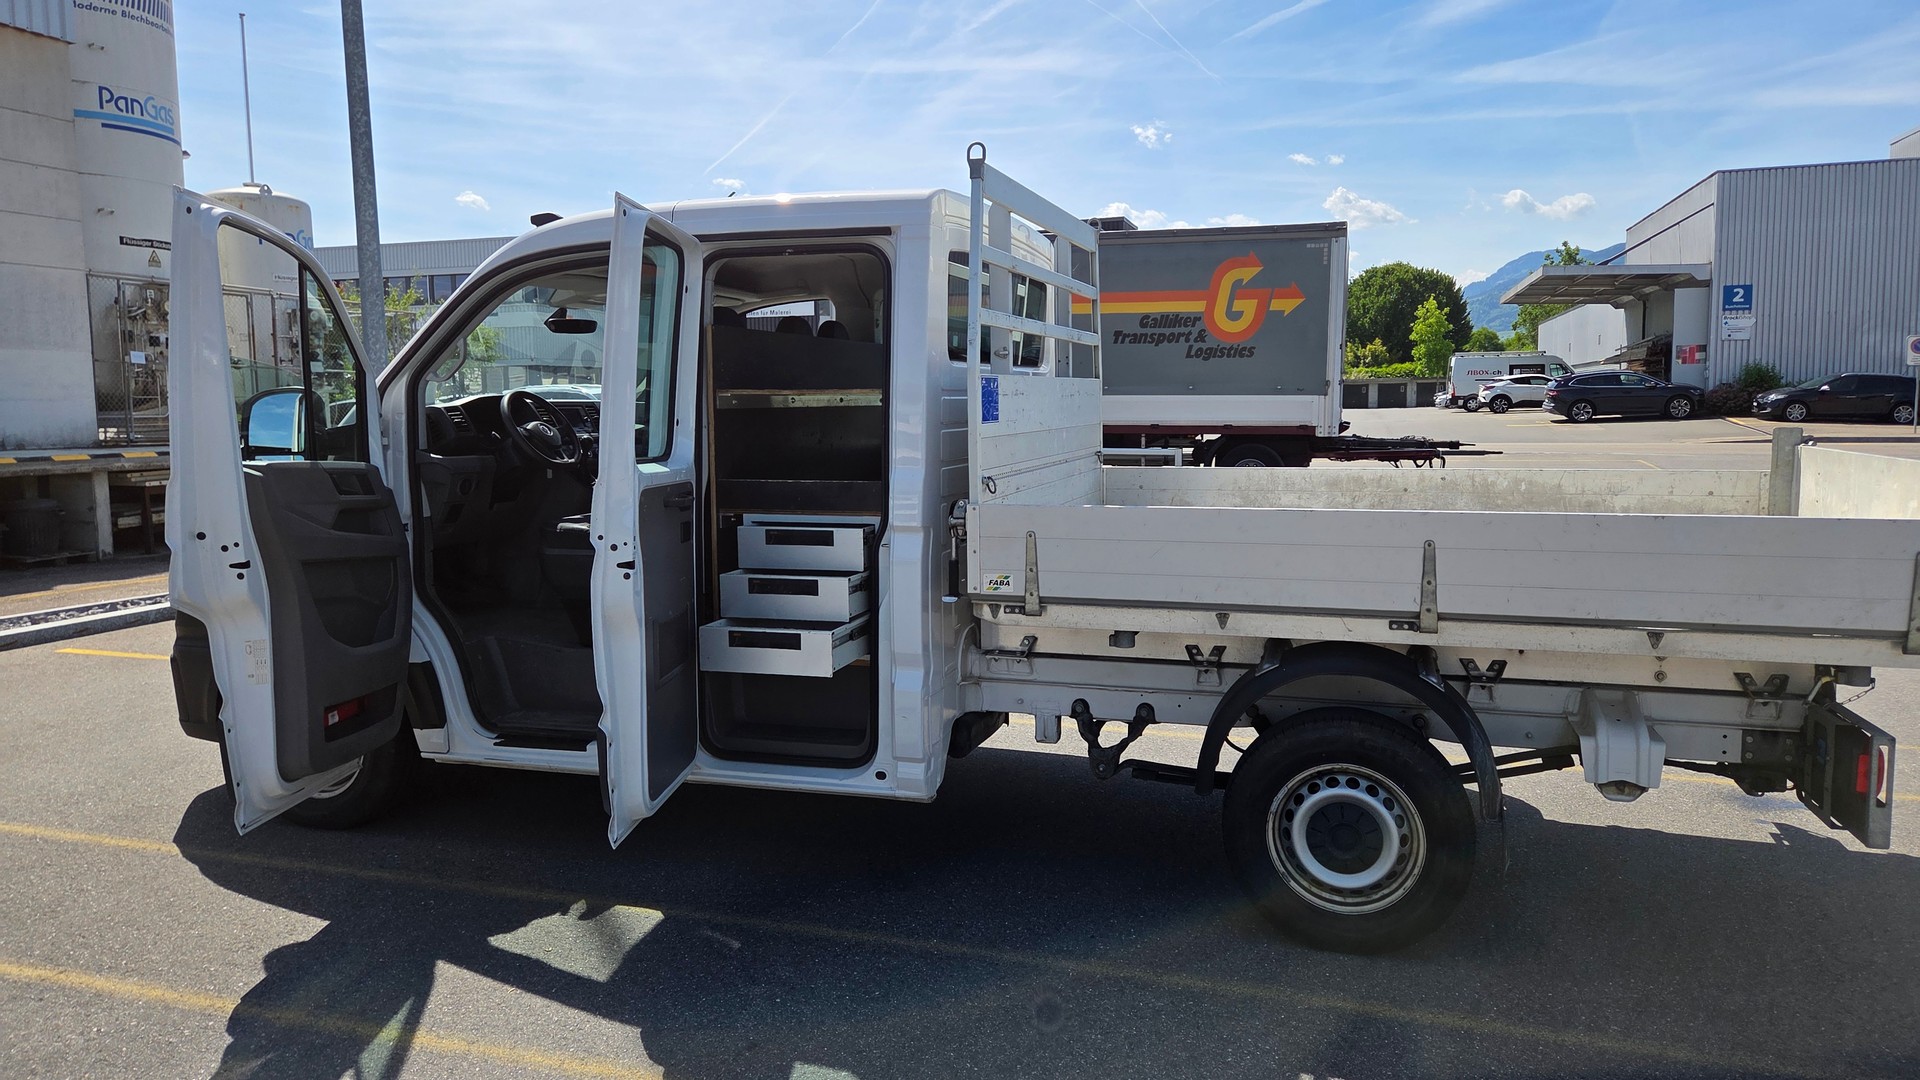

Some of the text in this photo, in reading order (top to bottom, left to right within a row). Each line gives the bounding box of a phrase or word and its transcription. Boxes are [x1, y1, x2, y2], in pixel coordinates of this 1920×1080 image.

[98, 85, 175, 126] PanGas
[1733, 288, 1744, 302] 2
[1139, 313, 1202, 329] Galliker
[1113, 328, 1208, 347] Transport &
[1185, 344, 1256, 361] Logistics
[988, 579, 1011, 587] FABA
